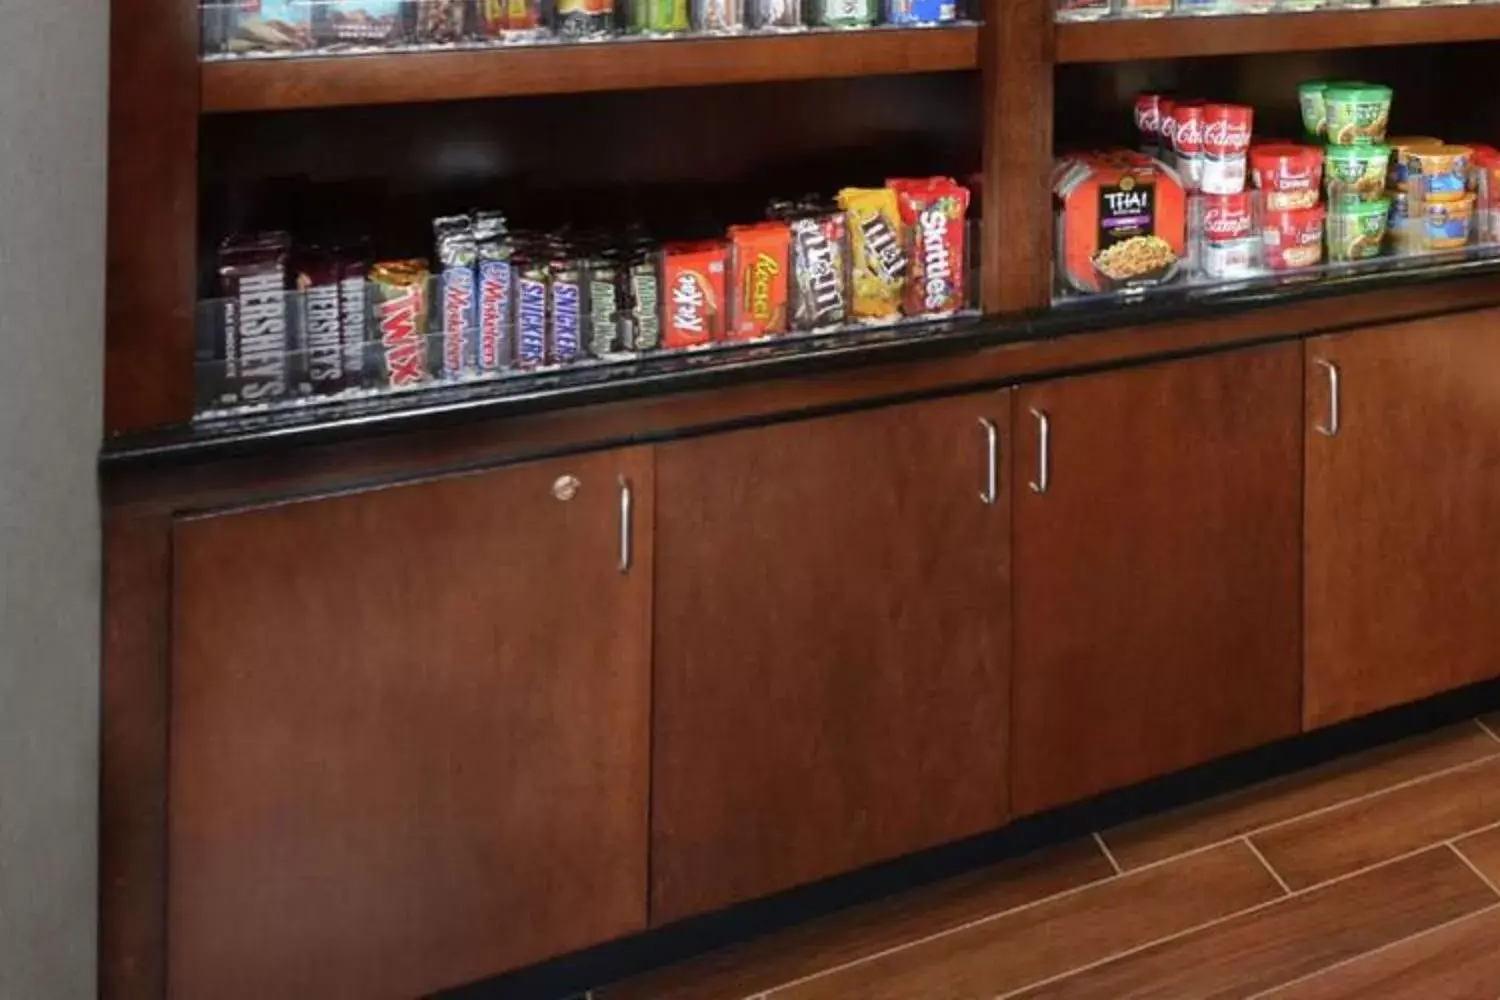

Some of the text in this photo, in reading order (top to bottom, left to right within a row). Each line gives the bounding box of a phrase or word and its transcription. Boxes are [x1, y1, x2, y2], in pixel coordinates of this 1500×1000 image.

[1104, 192, 1148, 210] THAI
[920, 210, 951, 309] Skittles
[239, 272, 286, 399] HERSHEY'S
[307, 284, 342, 381] HERSHEY'S
[381, 287, 425, 388] TWIX
[520, 279, 545, 362] SNICKERS
